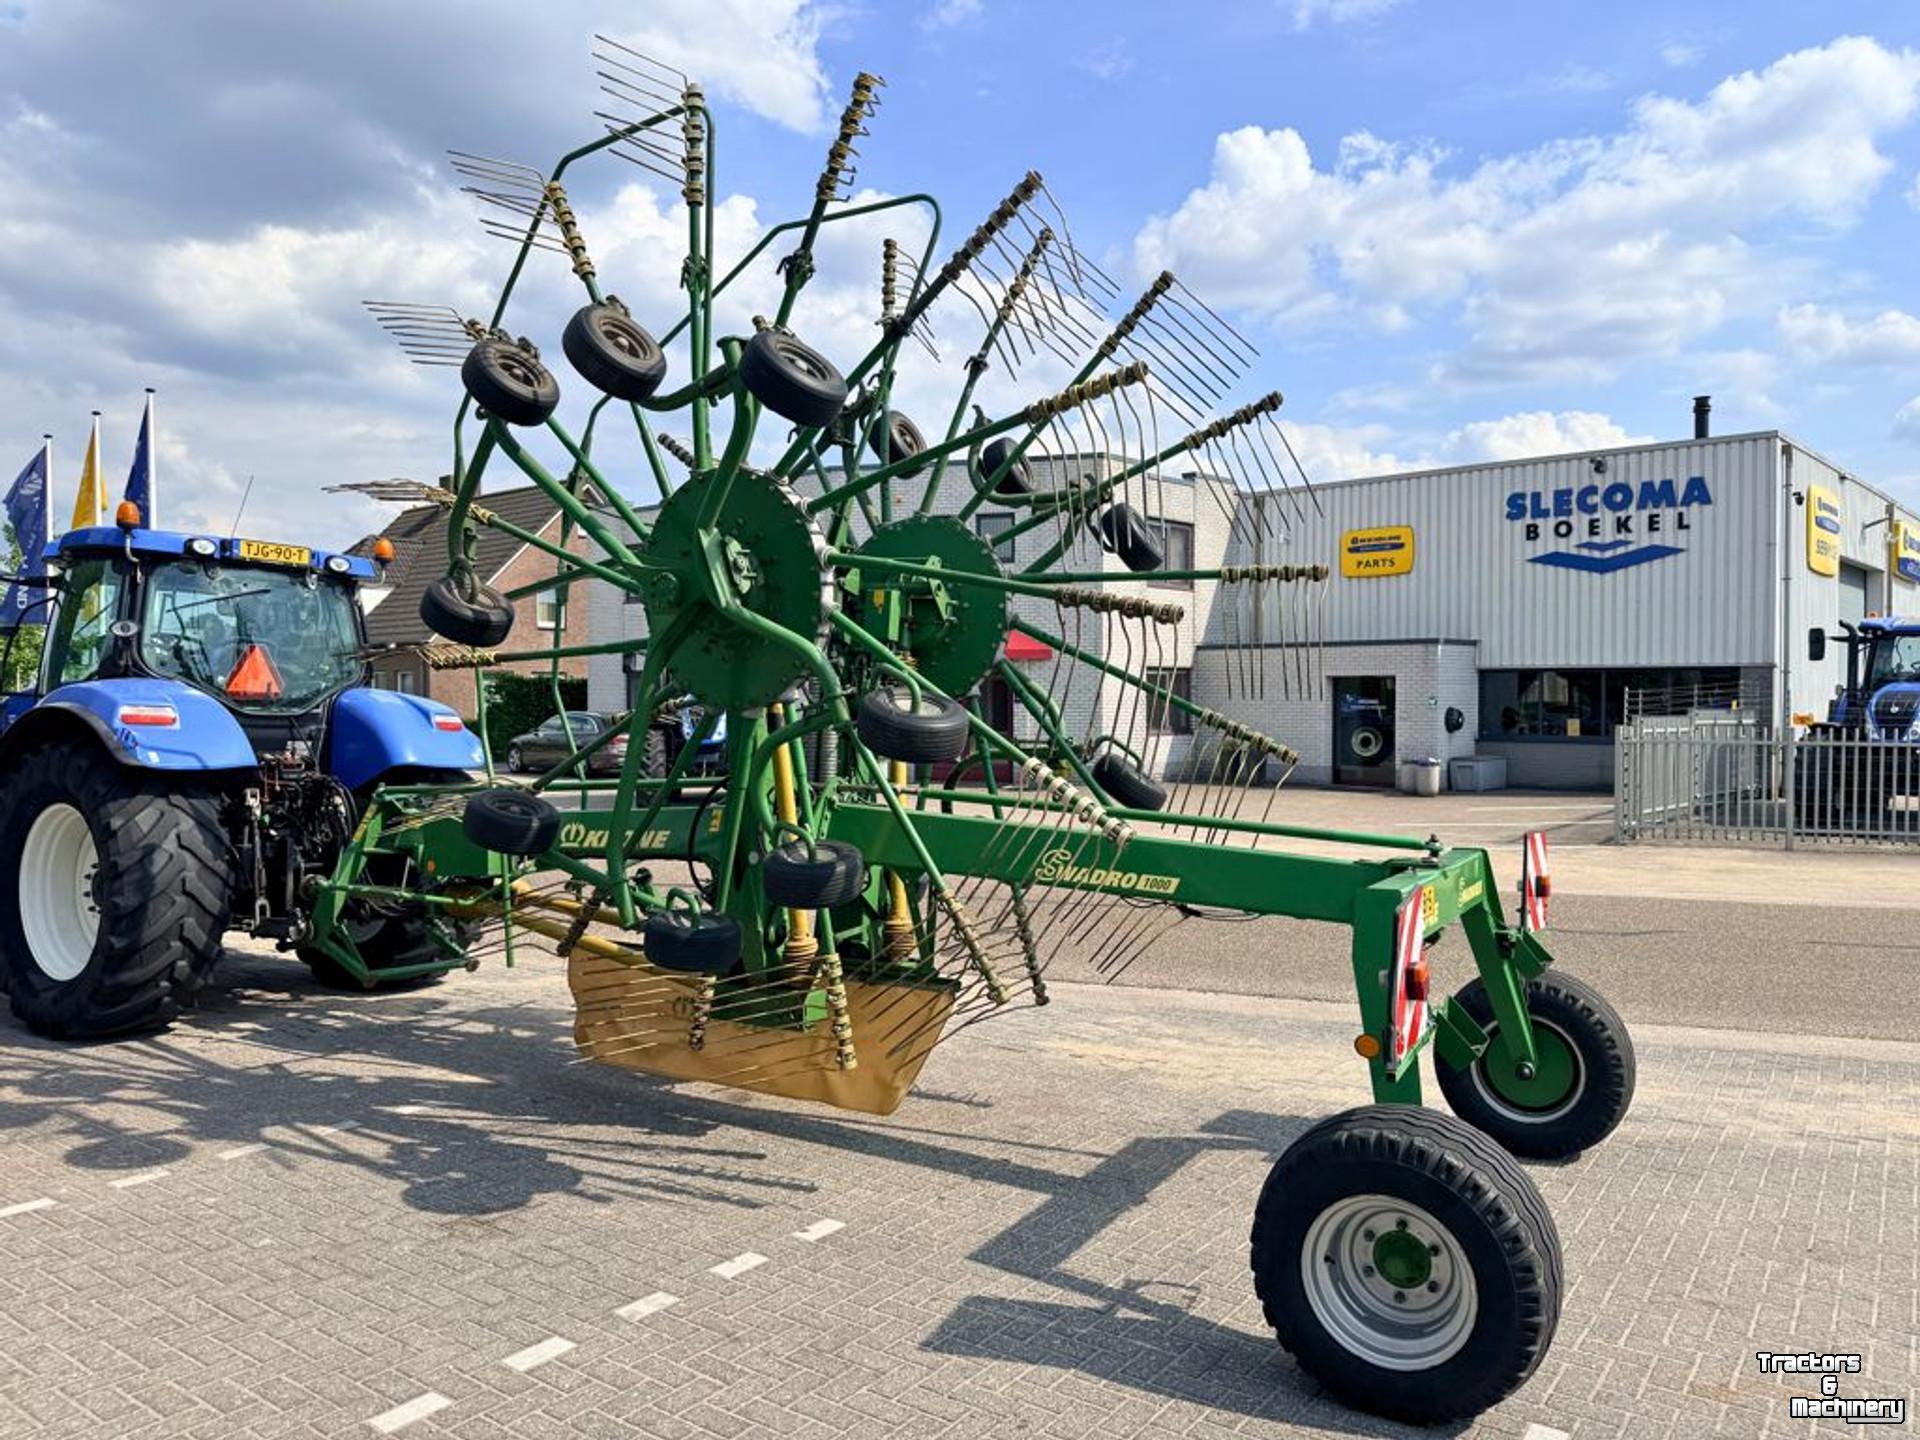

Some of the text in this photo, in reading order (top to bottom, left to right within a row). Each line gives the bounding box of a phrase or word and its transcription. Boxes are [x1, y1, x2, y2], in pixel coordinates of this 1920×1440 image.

[1505, 476, 1713, 521] SLECOMA
[1525, 511, 1691, 541] BOEKEL
[246, 541, 305, 562] TJG-90-T
[1356, 557, 1397, 570] PARTS
[583, 829, 671, 849] KNE
[1143, 877, 1173, 891] 1000
